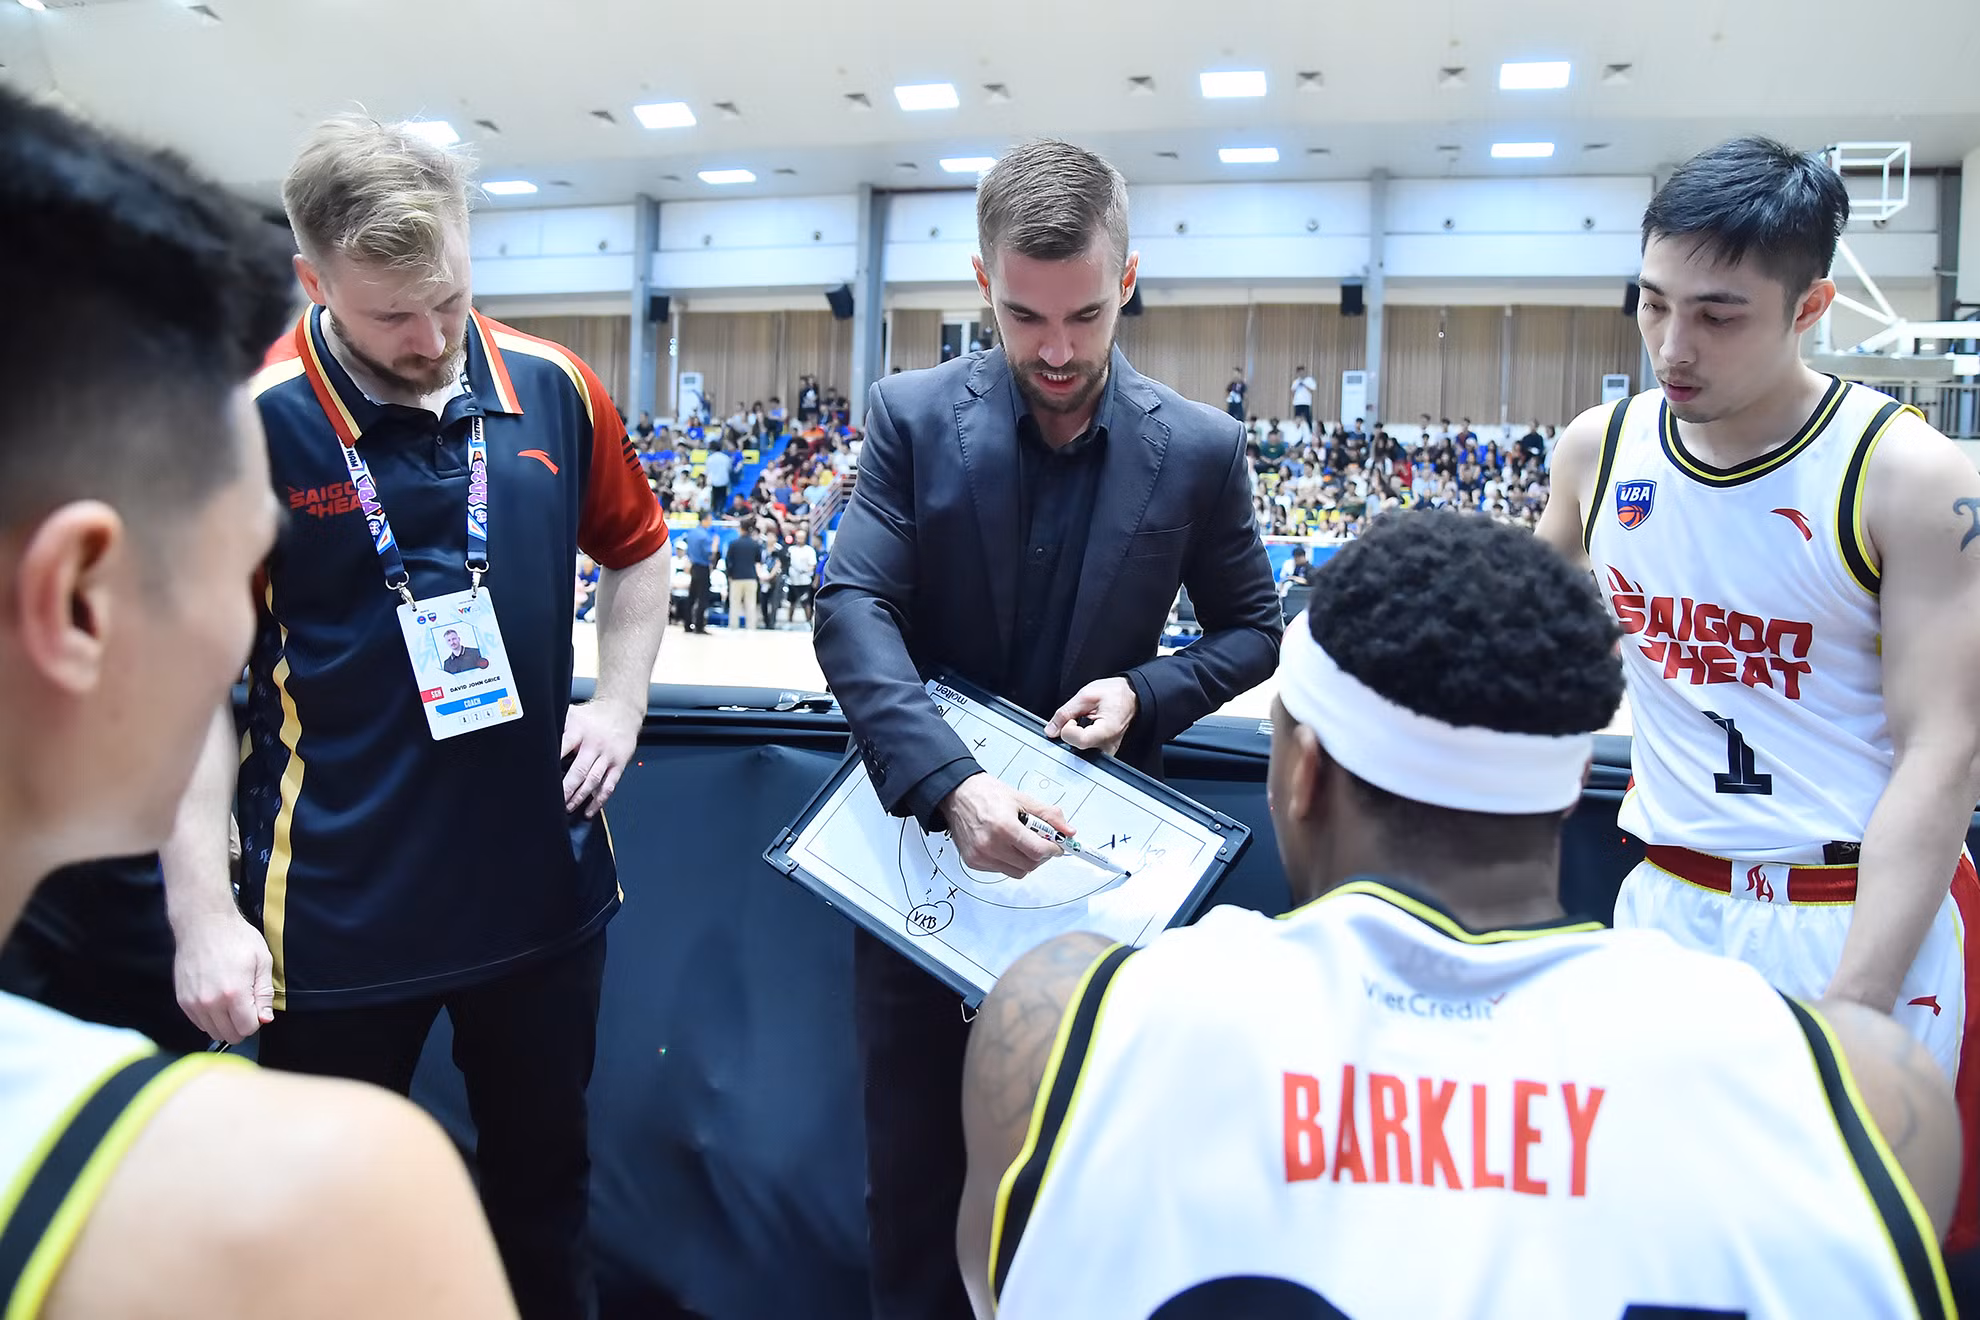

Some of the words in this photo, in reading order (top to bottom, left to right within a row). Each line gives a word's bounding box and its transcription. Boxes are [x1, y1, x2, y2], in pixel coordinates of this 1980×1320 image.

[290, 480, 357, 509] SAIGO
[356, 475, 382, 516] VBA
[468, 460, 488, 505] 2023
[1619, 485, 1651, 502] VBA
[306, 496, 362, 518] HEA
[1611, 592, 1814, 658] SAIGON
[449, 684, 467, 693] DAVID
[468, 680, 484, 688] JOHN
[484, 675, 501, 684] GRICE
[1640, 638, 1813, 700] HEAT
[463, 698, 482, 709] COACH
[935, 684, 968, 705] molten
[1701, 711, 1772, 795] 1
[1282, 1063, 1606, 1197] BARKLEY
